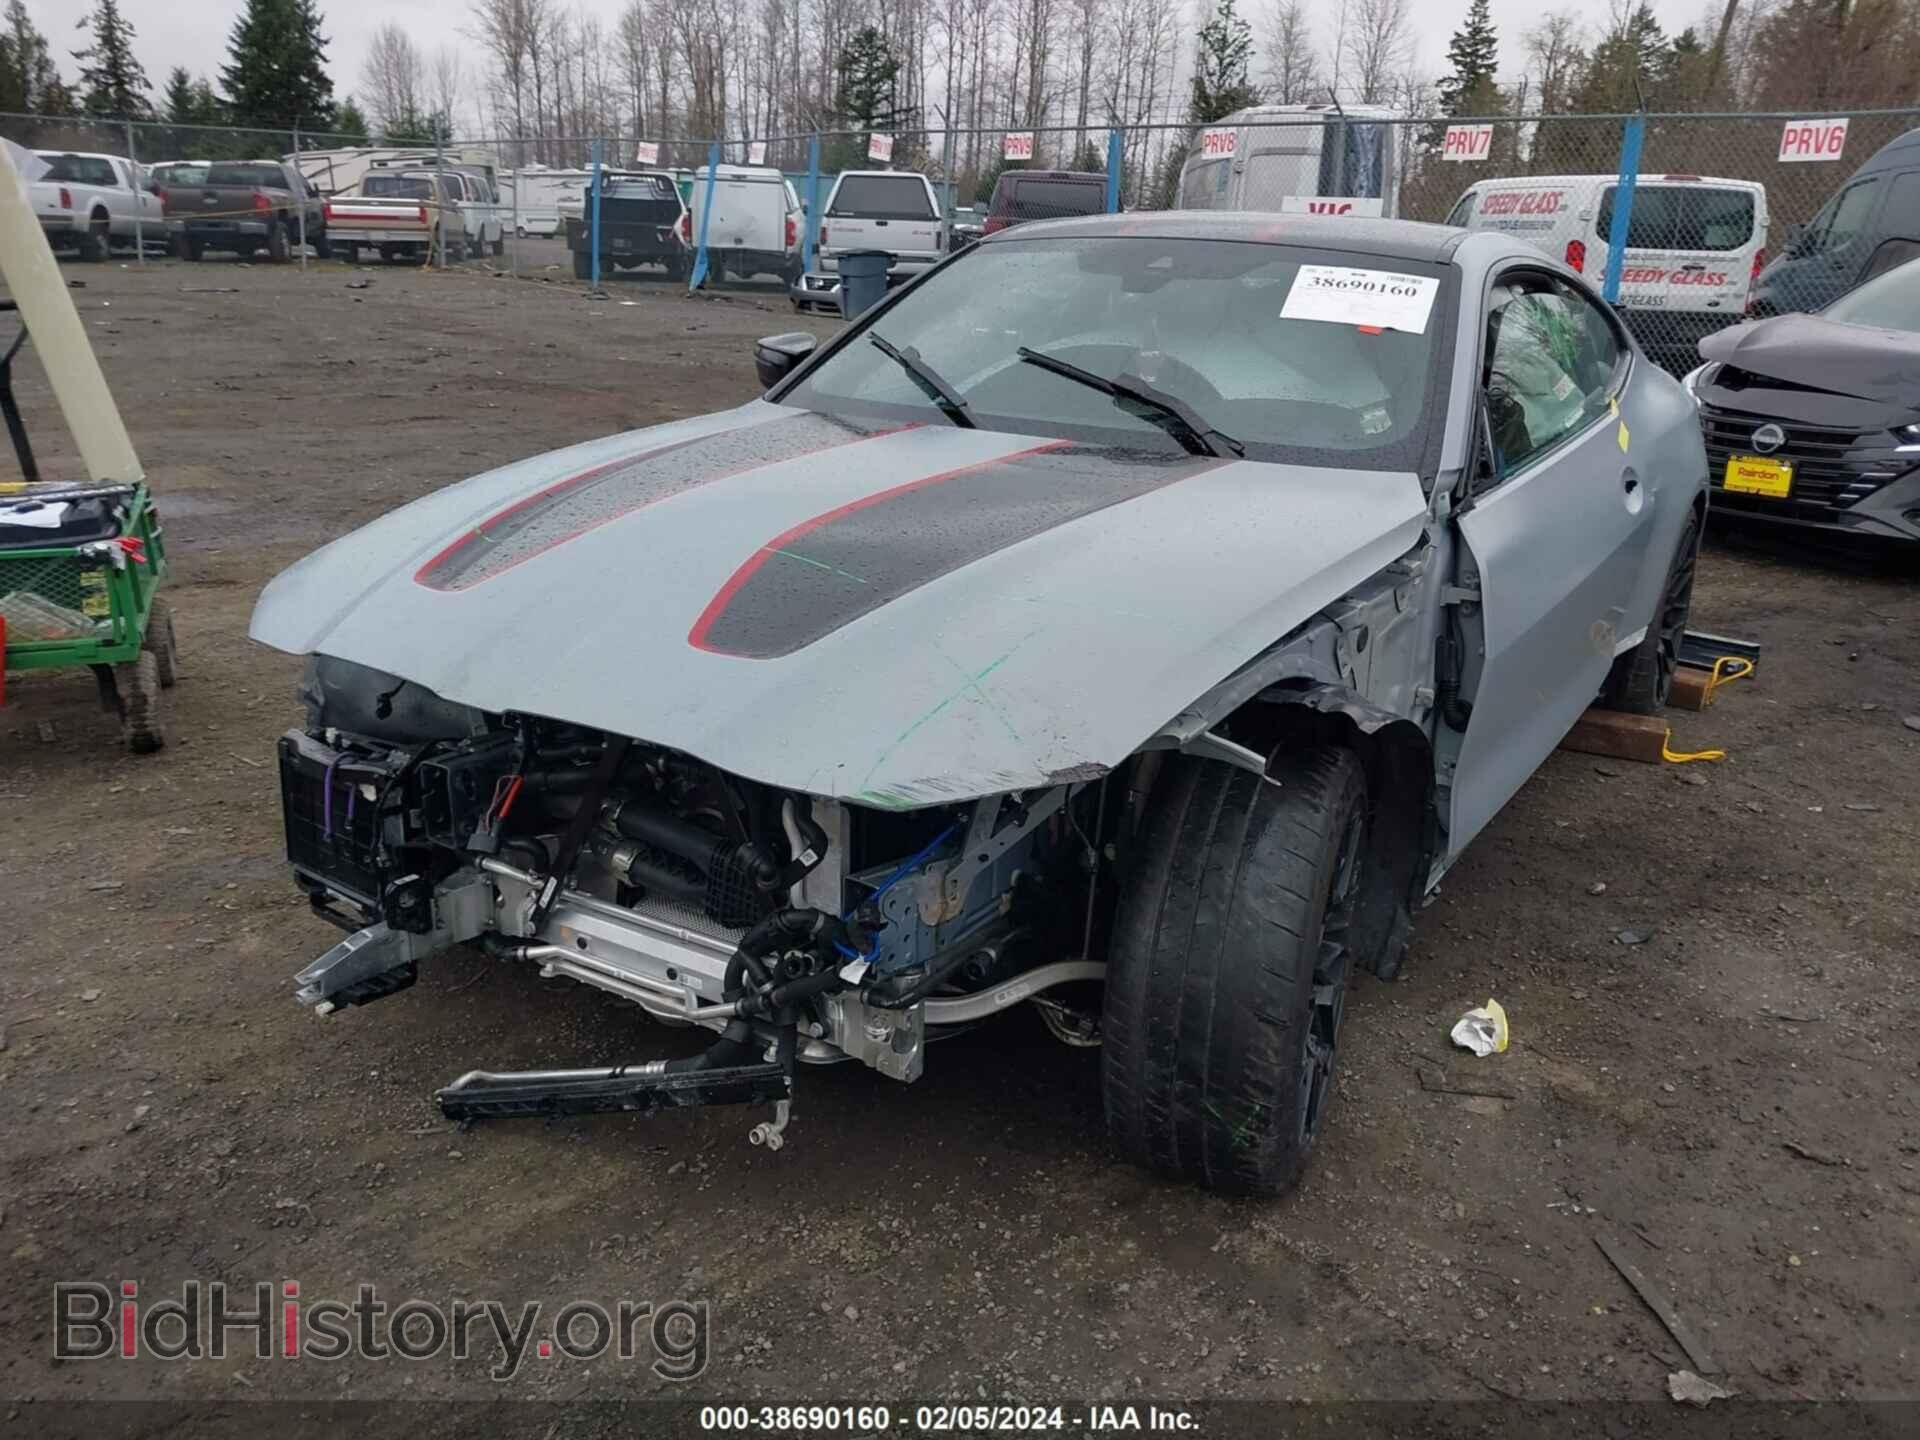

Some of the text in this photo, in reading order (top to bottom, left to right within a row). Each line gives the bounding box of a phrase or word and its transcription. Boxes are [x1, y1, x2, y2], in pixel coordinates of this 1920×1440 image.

[1204, 132, 1235, 153] PRV8
[1445, 130, 1490, 154] PRV7
[1782, 126, 1844, 155] PRV6
[1308, 276, 1418, 297] 38690160
[1669, 270, 1728, 287] GLASS
